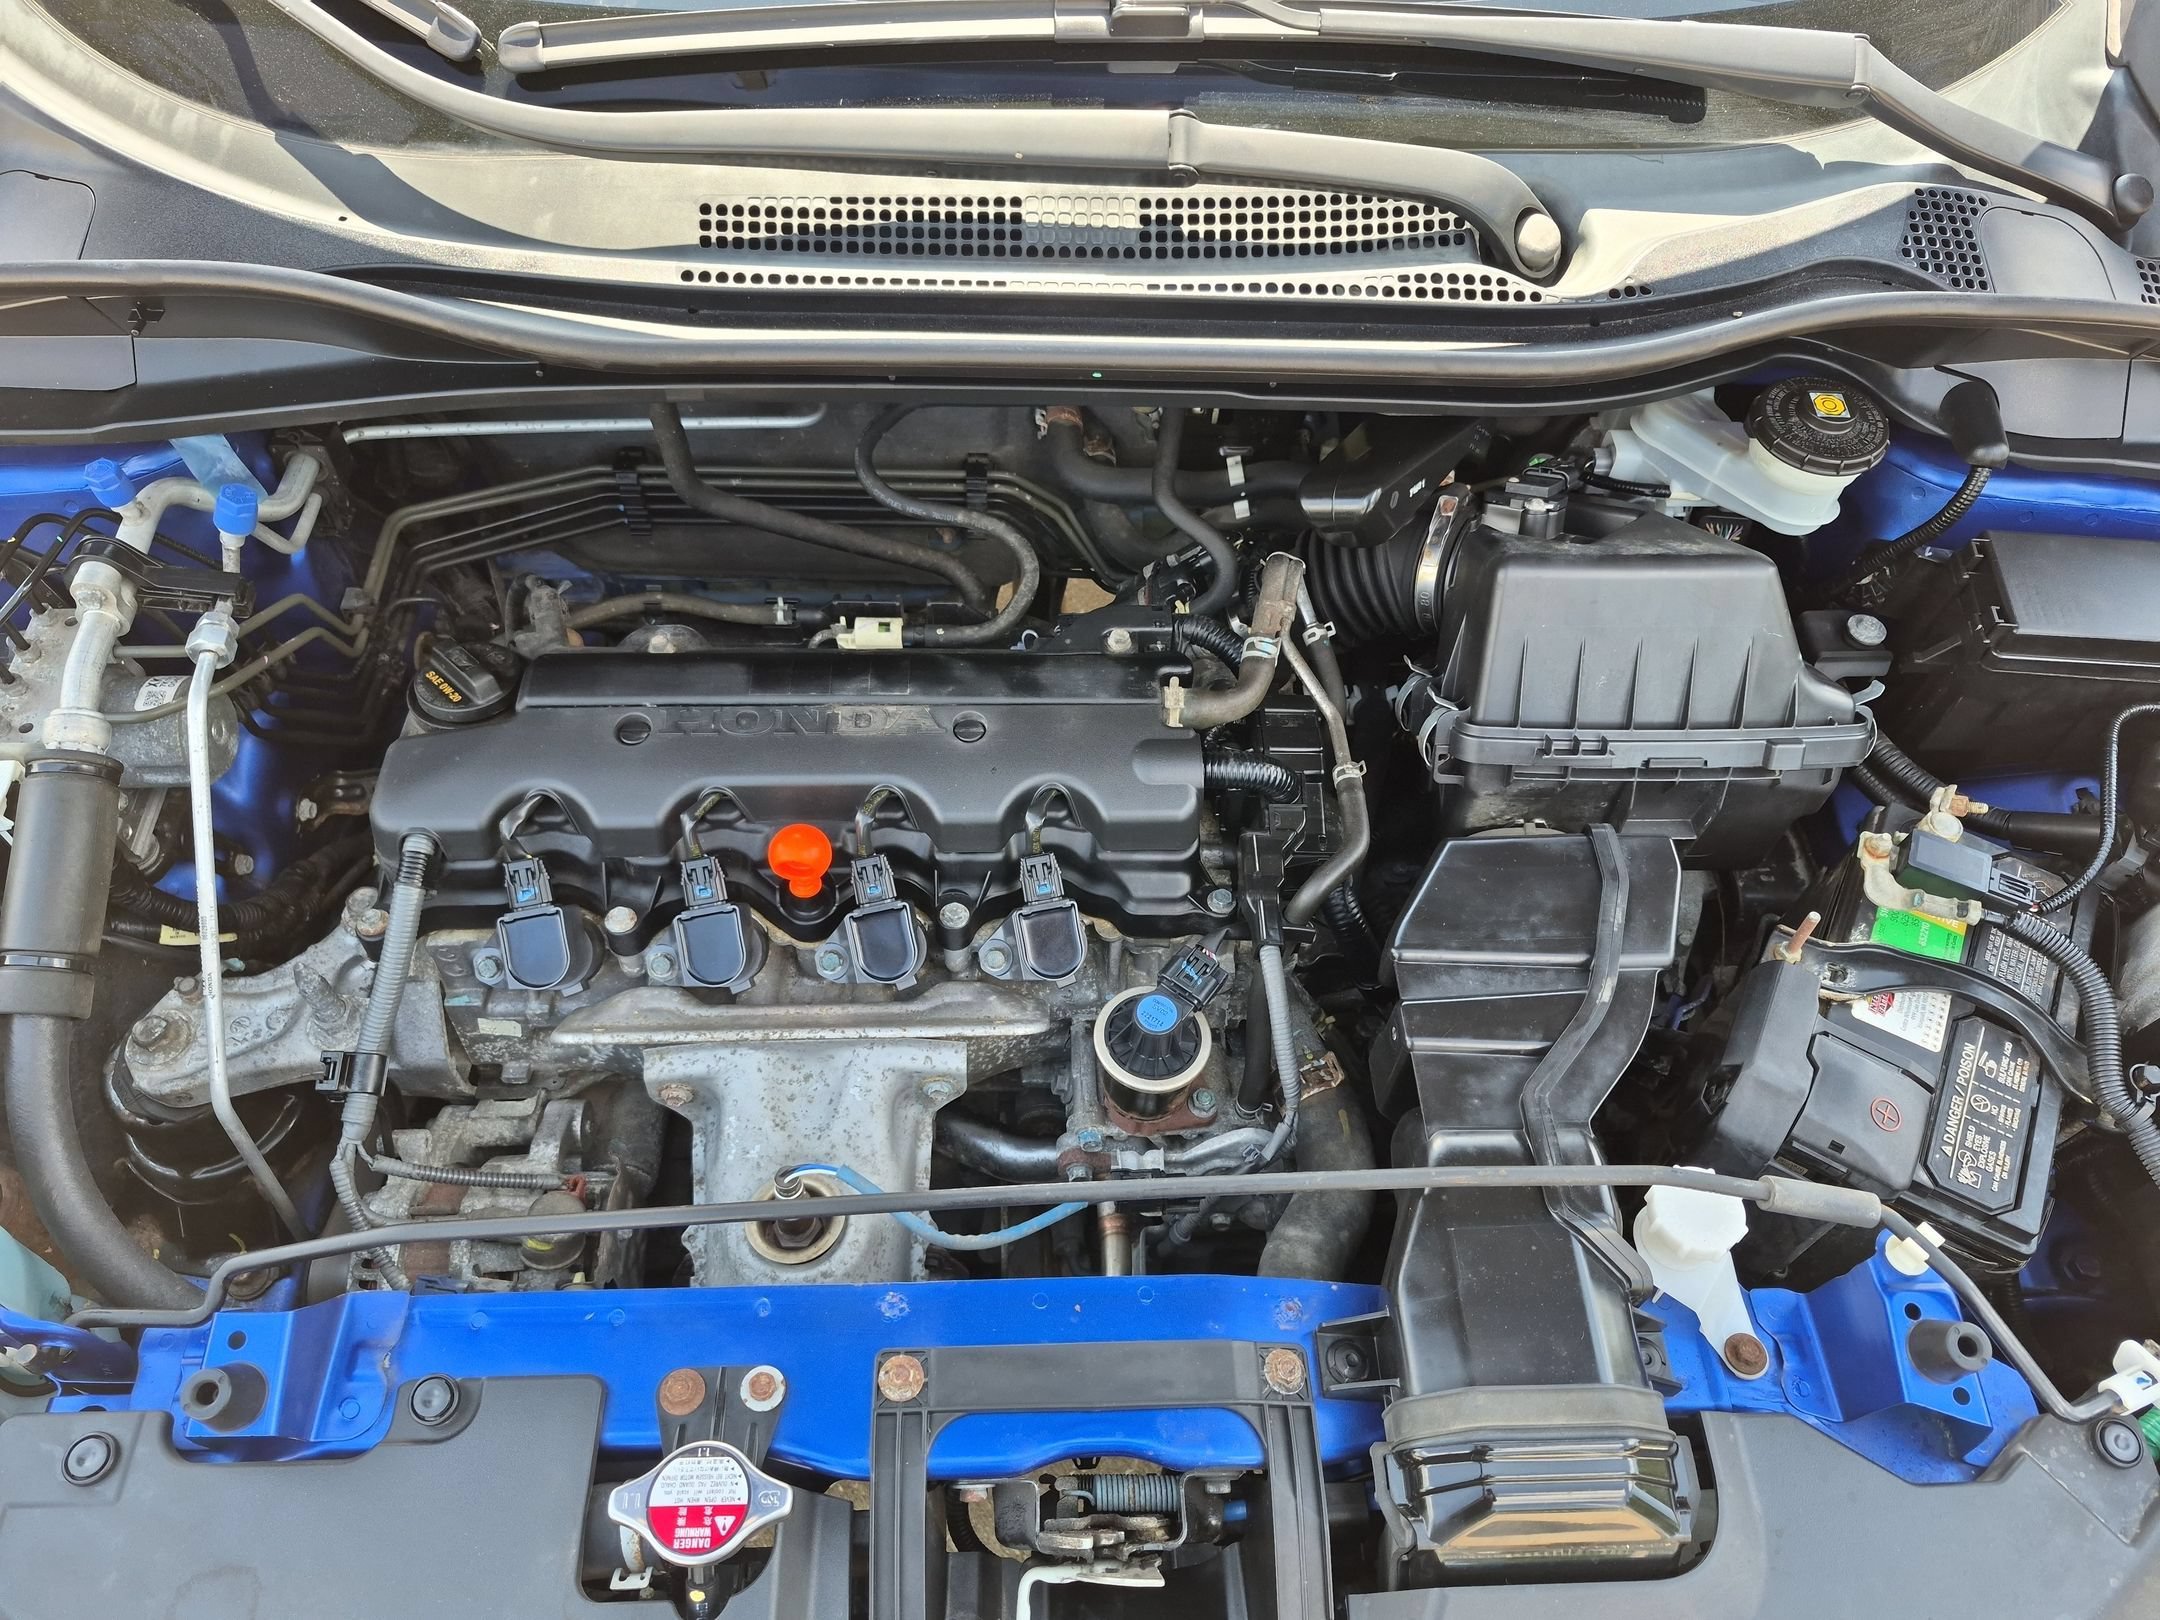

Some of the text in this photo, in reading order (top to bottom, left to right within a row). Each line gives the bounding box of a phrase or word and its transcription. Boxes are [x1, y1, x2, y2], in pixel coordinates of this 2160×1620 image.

[425, 671, 444, 685] SAE
[439, 683, 462, 703] 0W-20
[657, 705, 948, 736] HONDA
[2002, 947, 2011, 961] EYES
[2018, 948, 2027, 962] HELP
[1998, 960, 2009, 978] FLUSH
[2006, 966, 2015, 980] WITH
[2013, 962, 2024, 984] MEDICAL
[1997, 1041, 2013, 1084] SULFURIC ACID
[2007, 1061, 2016, 1076] CAUSE
[1943, 1095, 1964, 1145] DANGER
[1956, 1042, 1976, 1086] POISON
[1990, 1104, 2000, 1116] NO
[1964, 1124, 1976, 1149] SHIELD
[1972, 1134, 1983, 1152] EYES
[1977, 1135, 1991, 1169] EXPLOSIVE
[1985, 1150, 1997, 1173] GASES
[697, 1447, 711, 1457] 1.1
[675, 1527, 711, 1538] WARNUNG
[673, 1538, 710, 1548] DANGER
